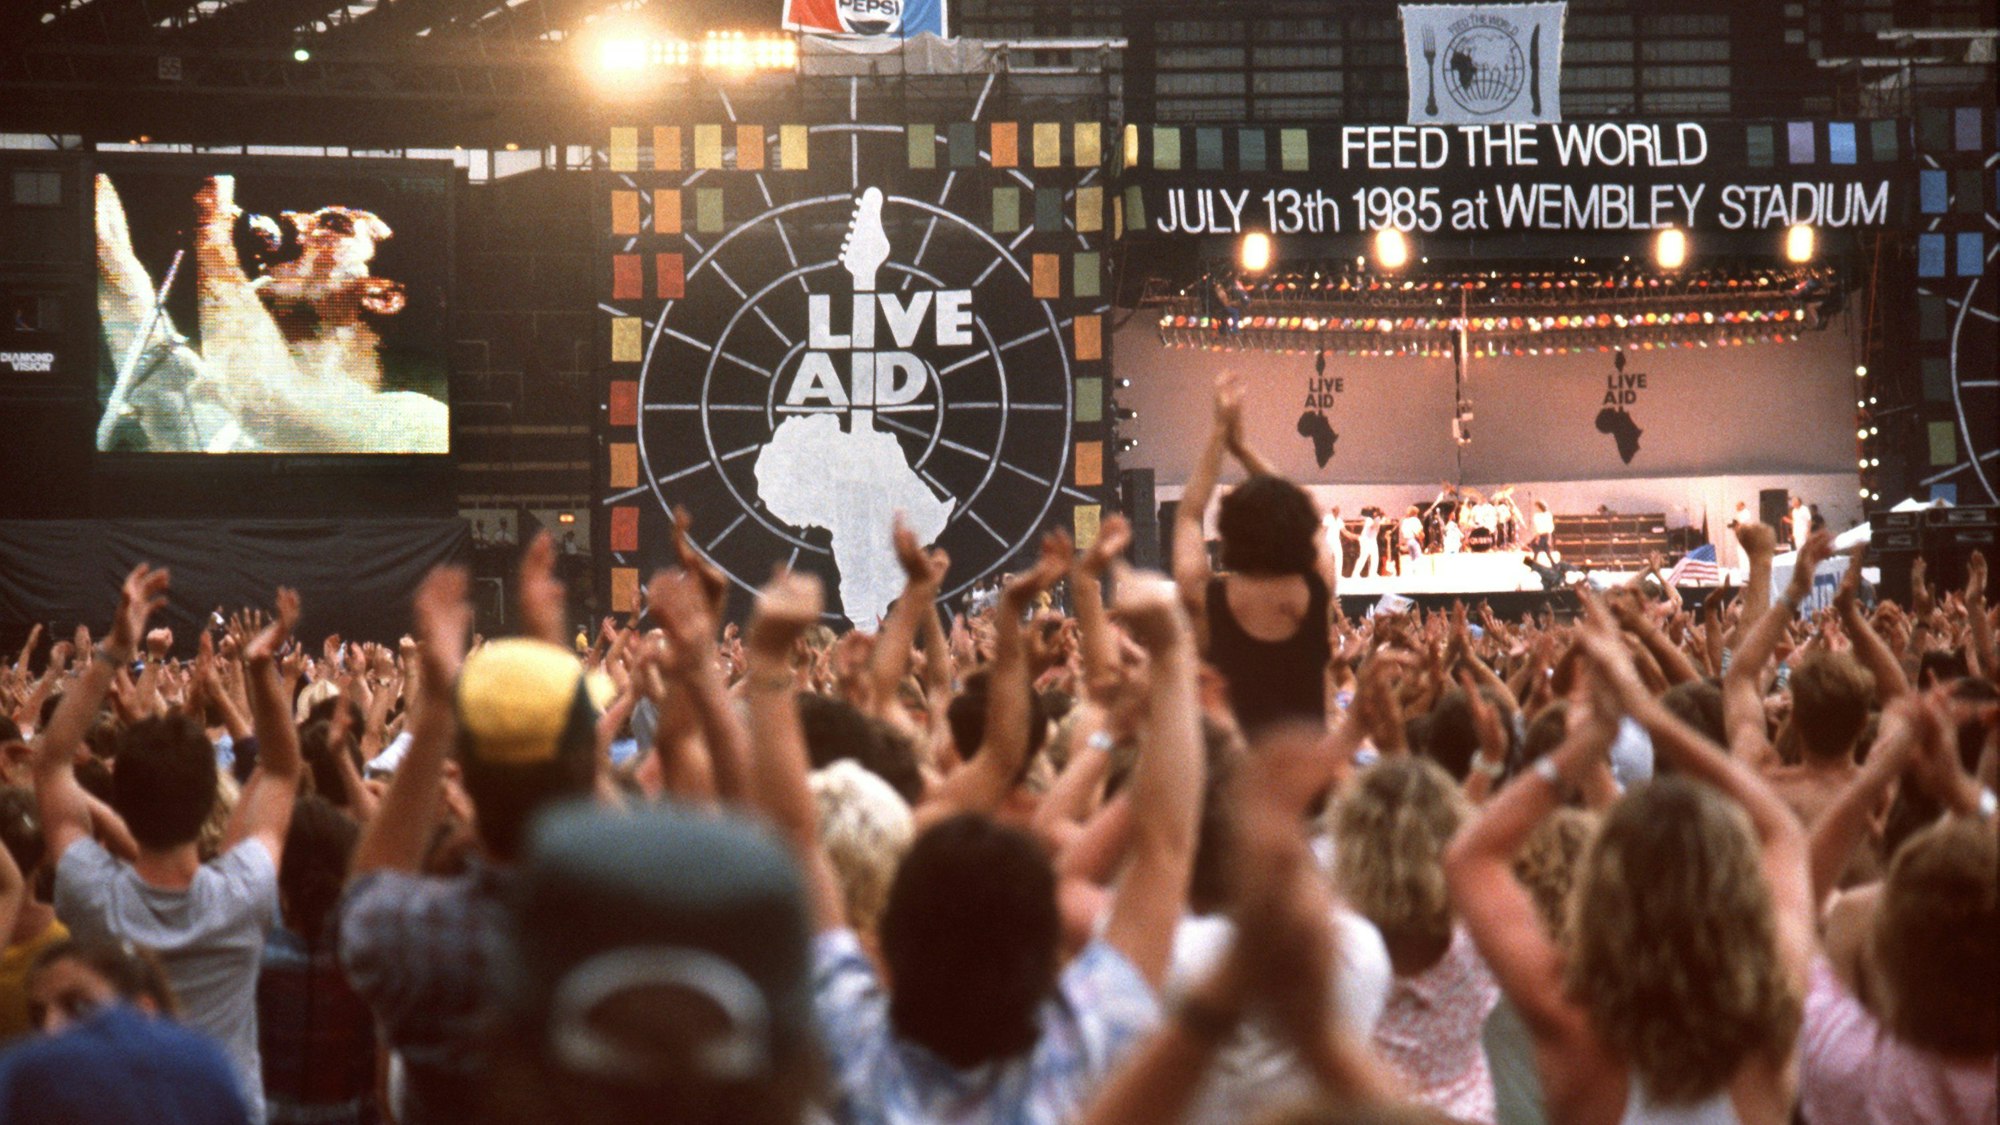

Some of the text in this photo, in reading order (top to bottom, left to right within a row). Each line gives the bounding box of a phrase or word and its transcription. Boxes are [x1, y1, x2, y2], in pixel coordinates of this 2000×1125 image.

[842, 0, 898, 22] PEPSI
[1448, 13, 1519, 36] FEED THE WORLD
[1342, 123, 1708, 169] FEED THE WORLD
[1157, 180, 1889, 234] JULY 13th 1985 at WEMBLEY STADIUM
[809, 289, 972, 349] LIVE
[0, 352, 54, 363] DIAMOND
[13, 361, 51, 371] VISION
[785, 352, 928, 406] AID
[1309, 377, 1344, 393] LIVE
[1607, 373, 1647, 389] LIVE
[1304, 393, 1335, 408] AID
[1603, 390, 1637, 405] AID
